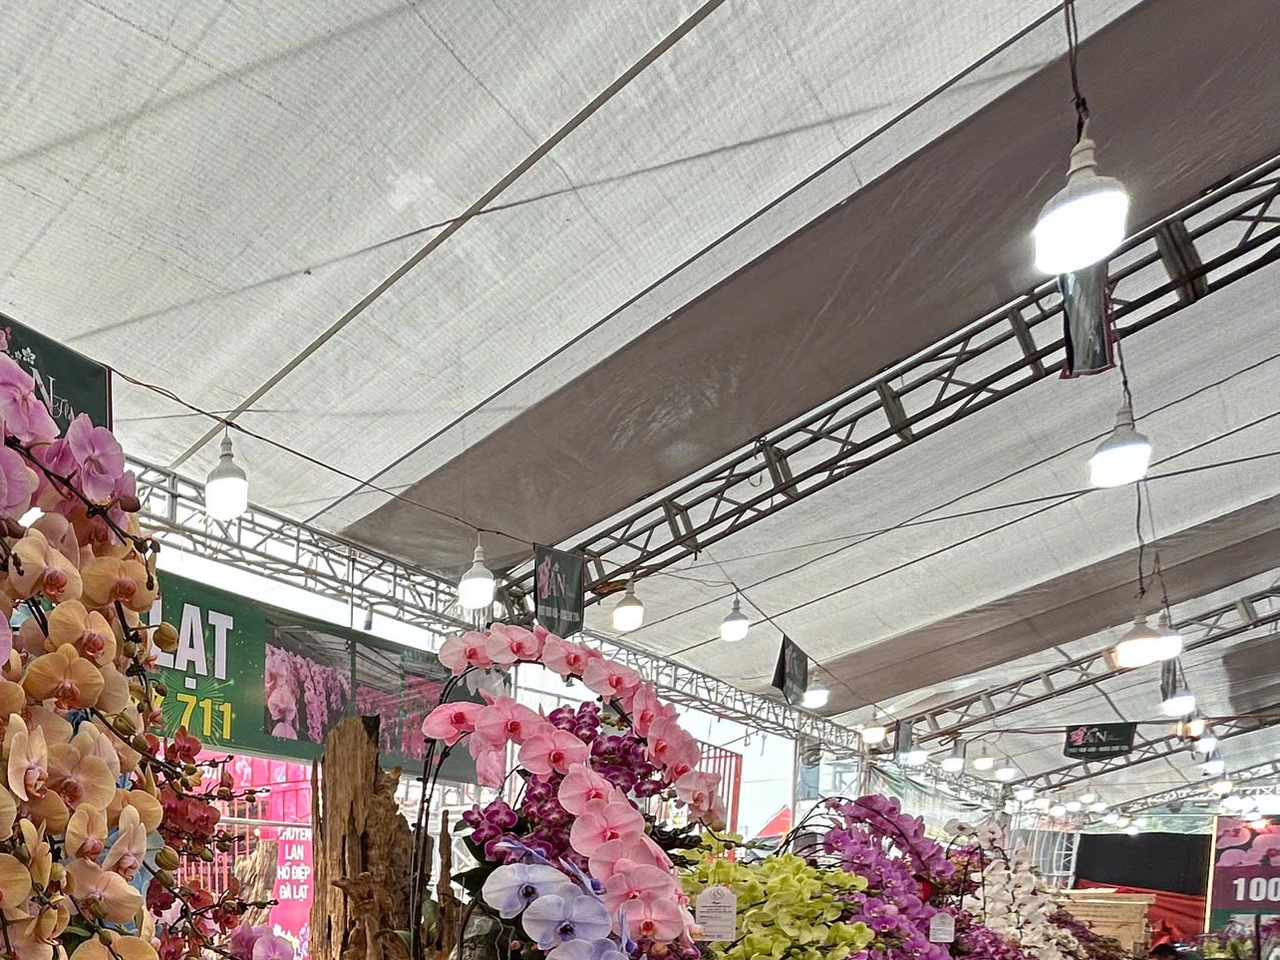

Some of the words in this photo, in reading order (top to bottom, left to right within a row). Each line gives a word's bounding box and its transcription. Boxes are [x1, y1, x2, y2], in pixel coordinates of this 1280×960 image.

[149, 596, 234, 690] LẠT
[177, 693, 232, 739] 711
[285, 844, 304, 860] LAN
[279, 882, 292, 900] ĐÀ
[293, 884, 309, 902] LẠT
